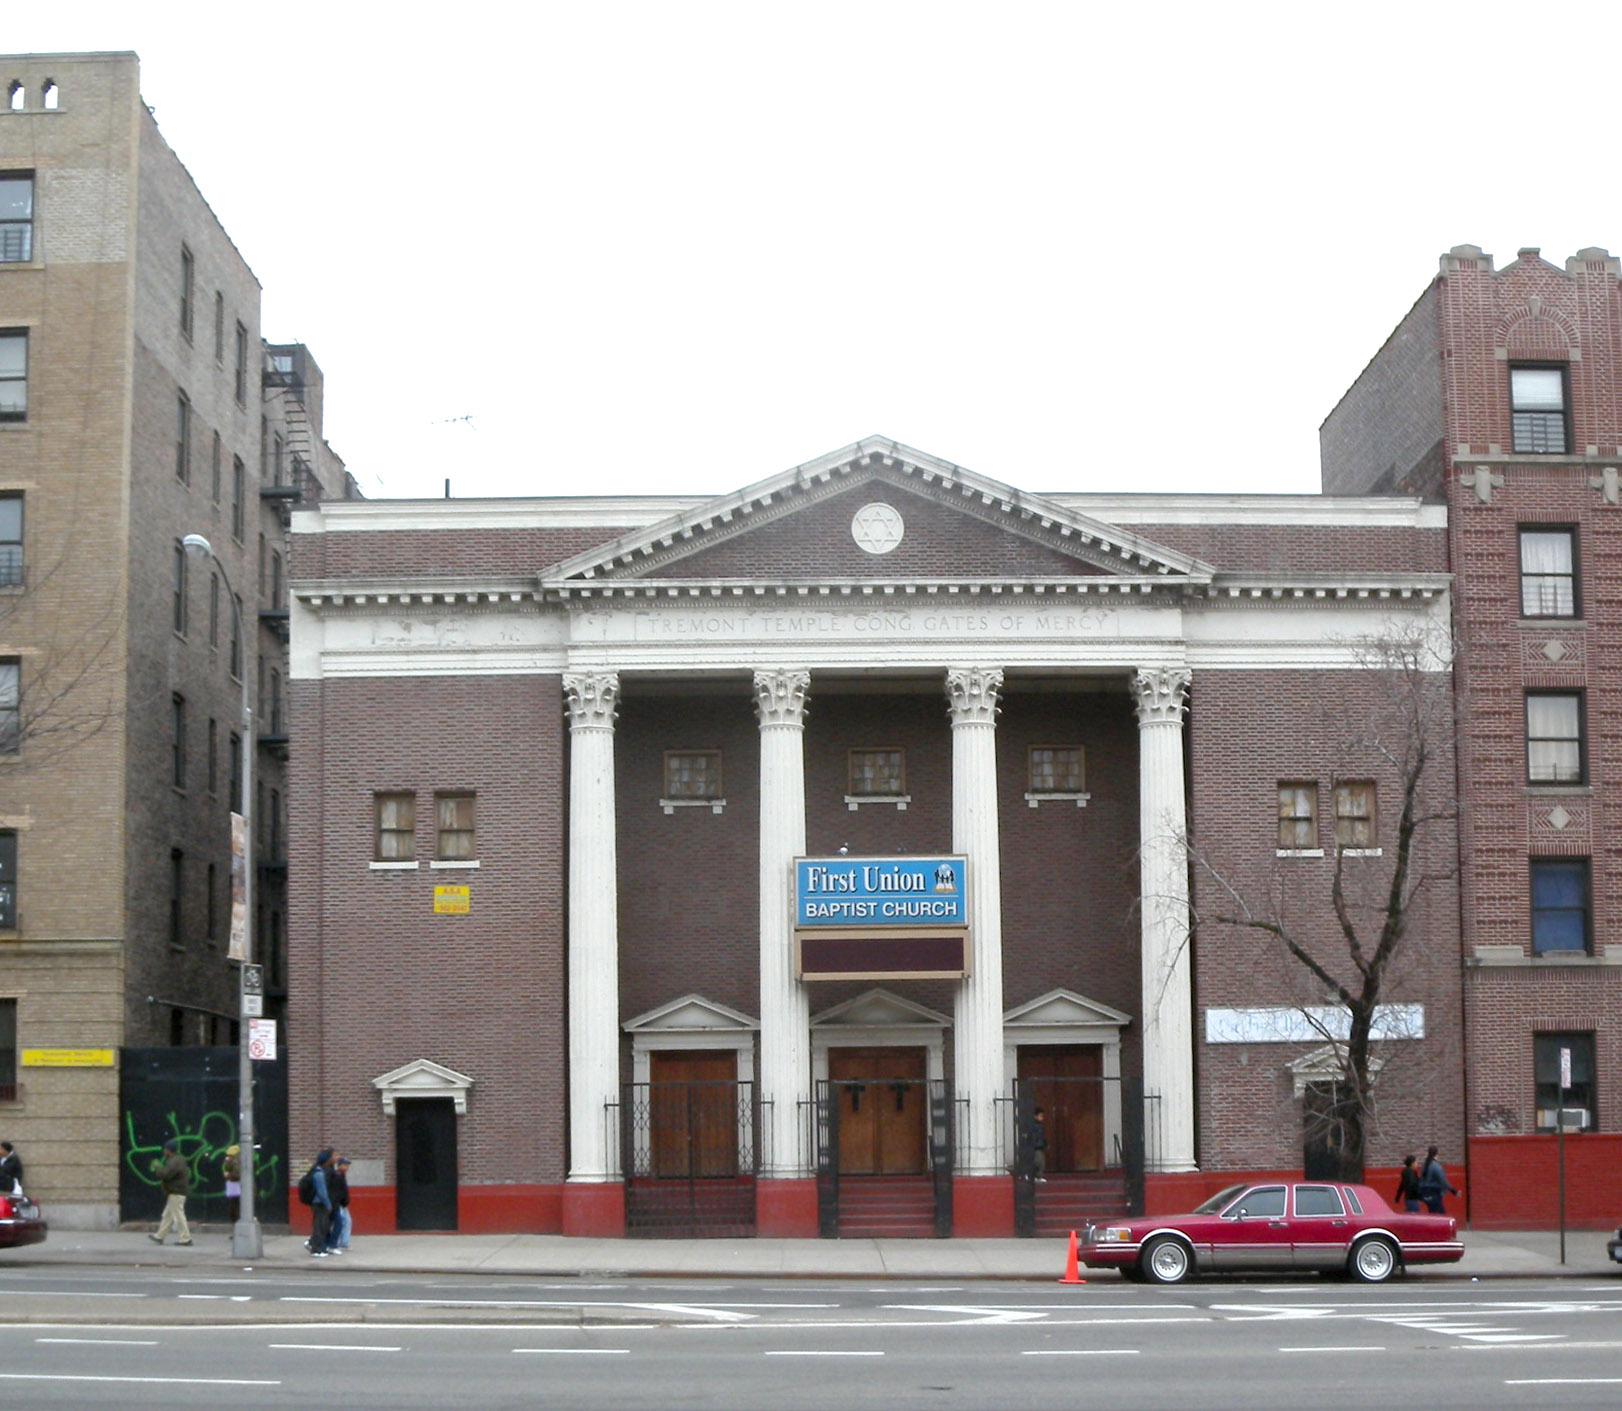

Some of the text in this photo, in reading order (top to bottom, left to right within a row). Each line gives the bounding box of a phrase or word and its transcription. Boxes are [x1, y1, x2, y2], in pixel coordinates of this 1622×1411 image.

[649, 616, 750, 634] TREMONT
[761, 615, 841, 633] TEMPLE
[923, 615, 989, 631] GATES
[1000, 615, 1025, 631] OF
[1035, 614, 1107, 631] MERCY
[807, 865, 926, 893] First Union
[805, 901, 957, 917] BAPTIST CHURCH
